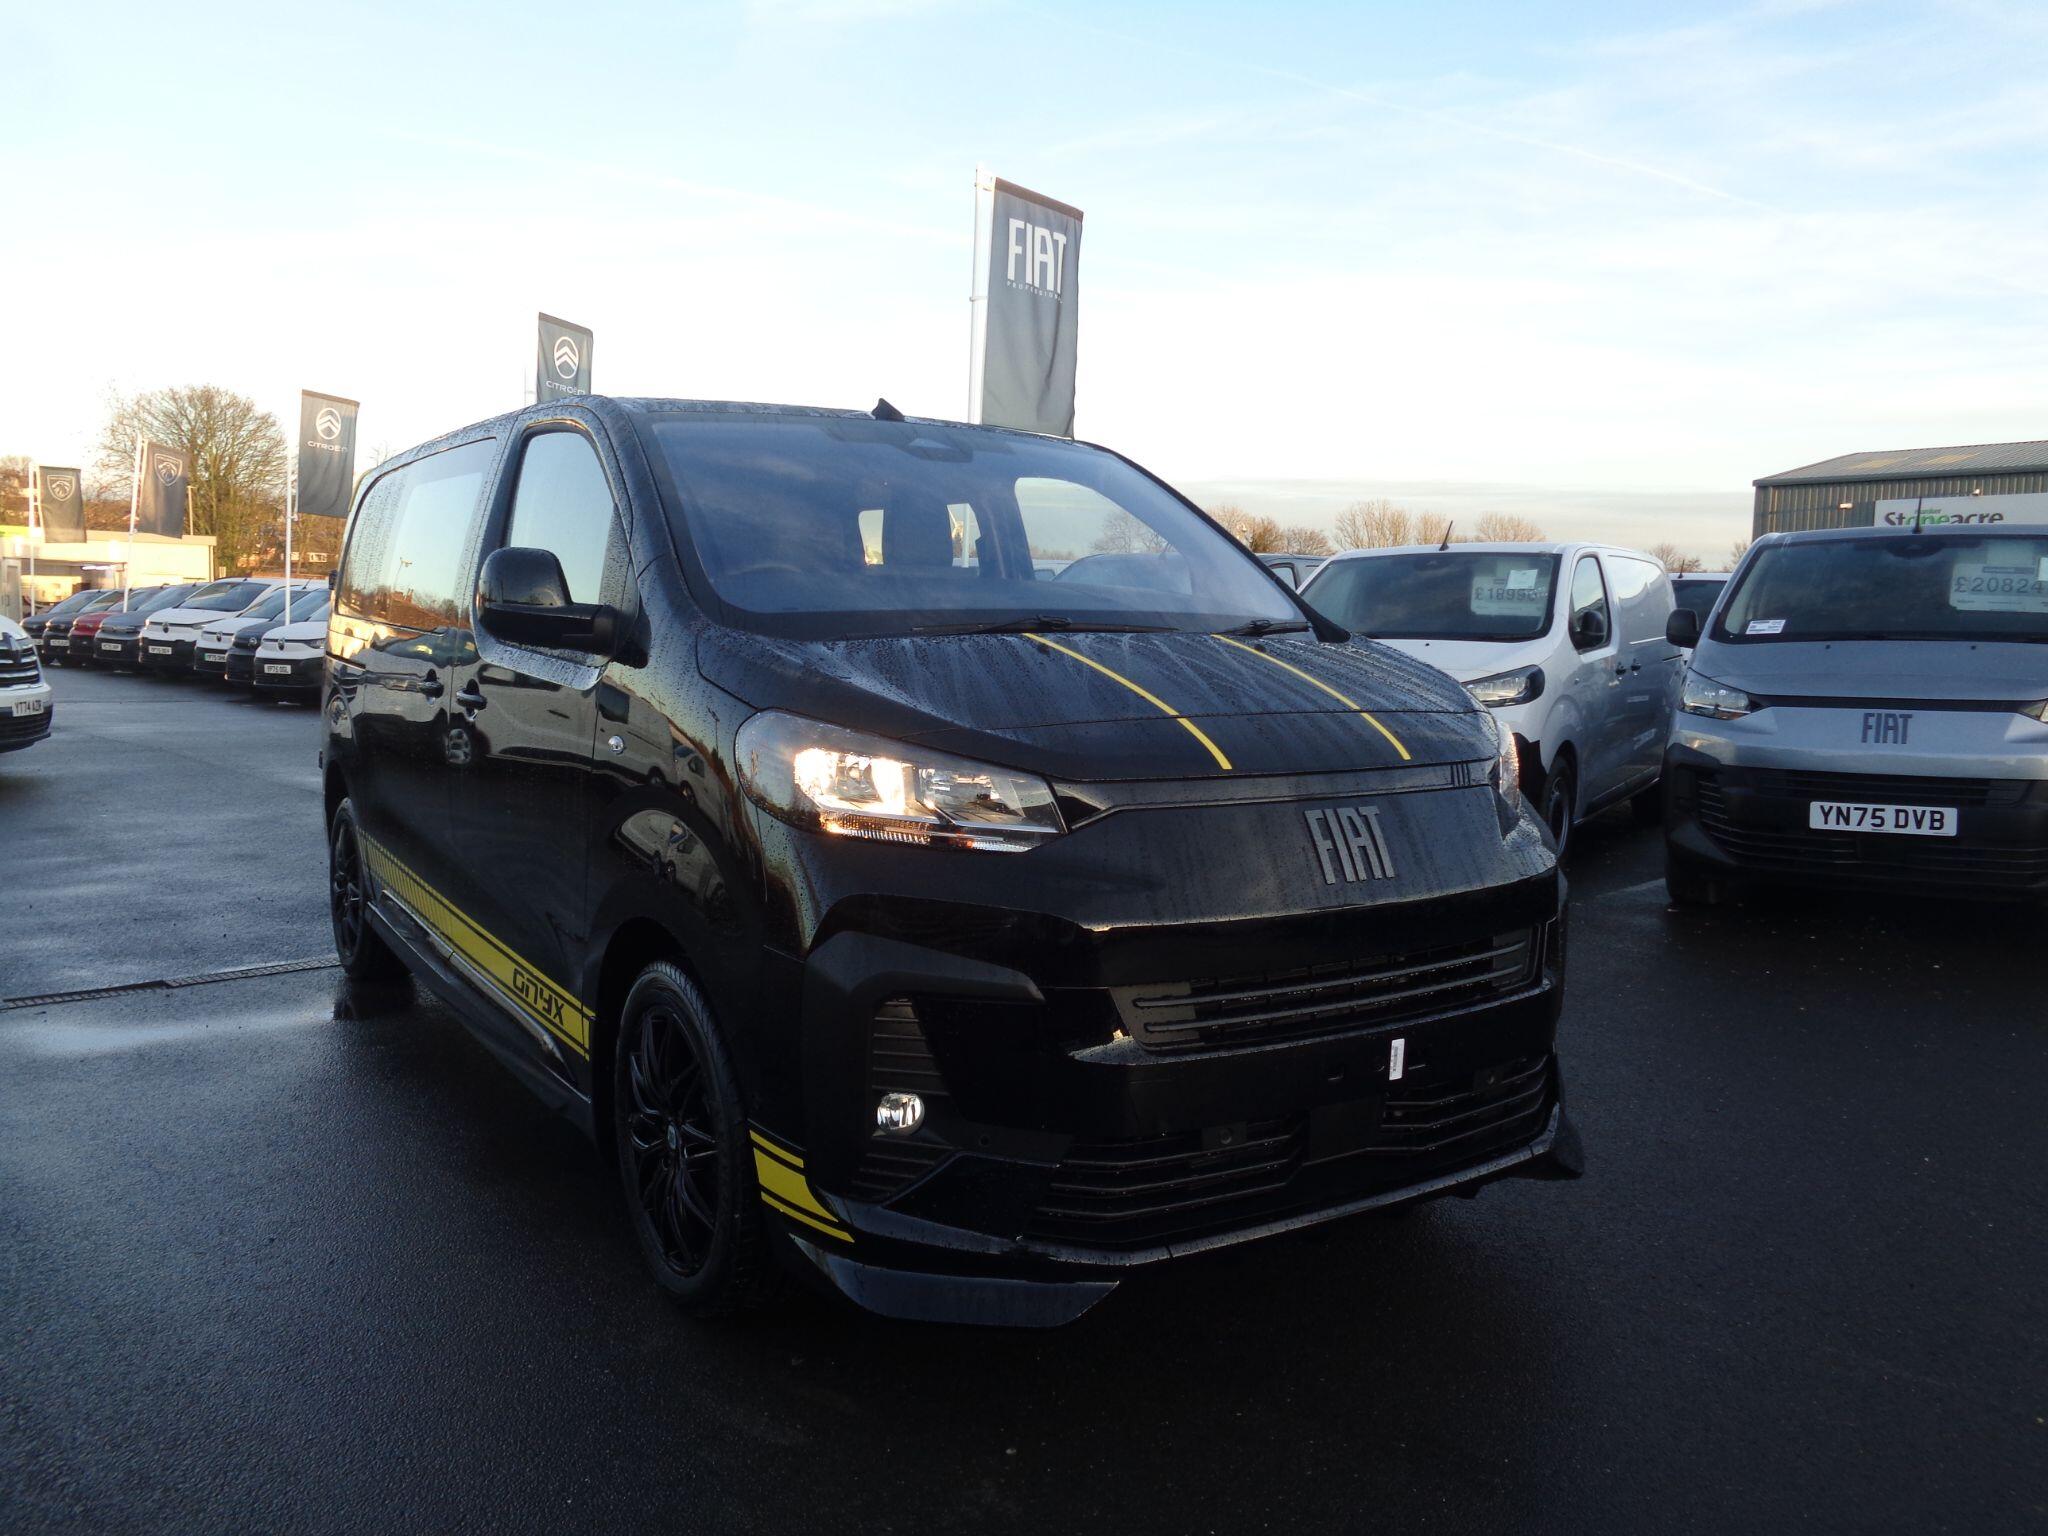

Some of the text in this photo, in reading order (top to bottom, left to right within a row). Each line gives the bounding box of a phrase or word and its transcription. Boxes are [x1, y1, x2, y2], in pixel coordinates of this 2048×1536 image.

[1007, 217, 1067, 295] FIAT
[1861, 712, 1913, 745] FIAT
[1303, 805, 1396, 885] FIAT
[1819, 804, 1945, 831] YN75 DVB
